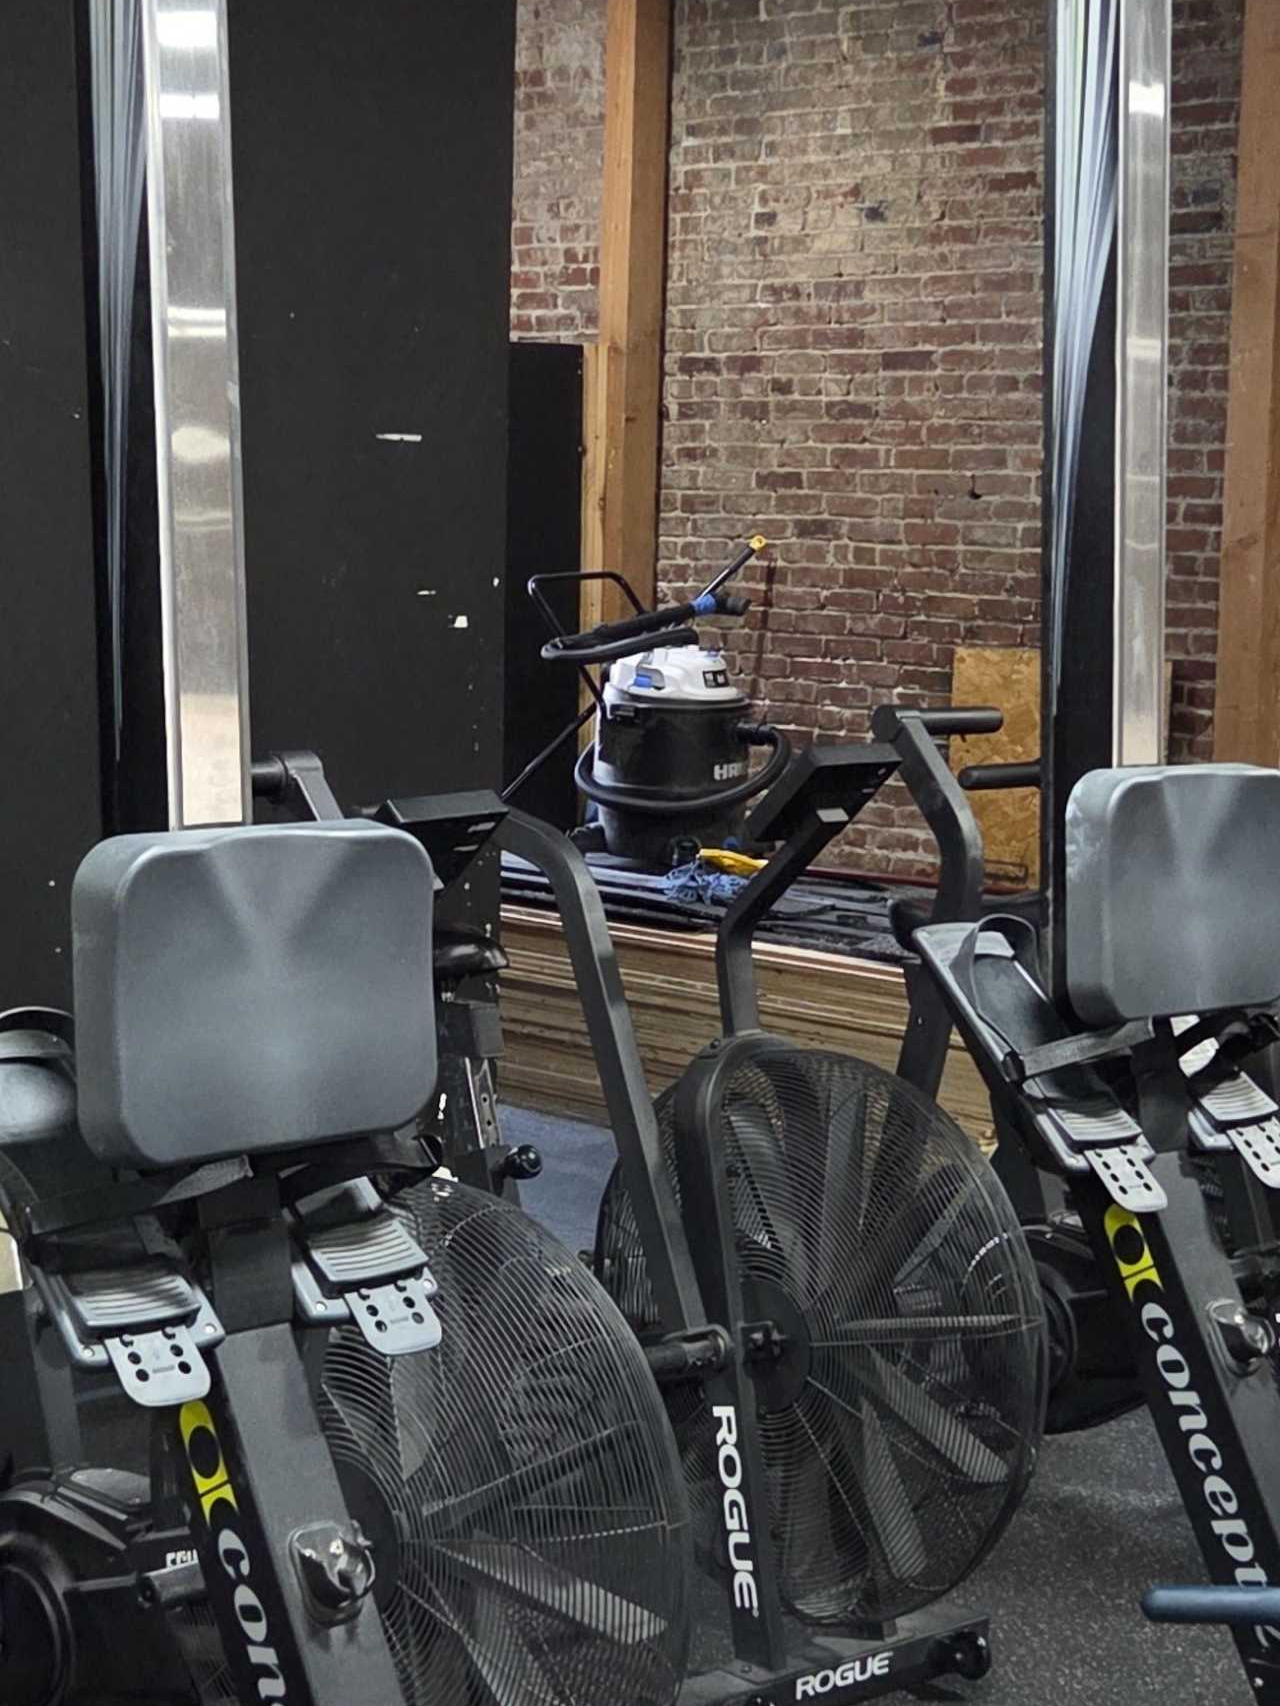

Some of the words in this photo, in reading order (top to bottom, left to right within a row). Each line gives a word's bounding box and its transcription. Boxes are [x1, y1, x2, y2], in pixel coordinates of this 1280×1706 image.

[711, 1404, 761, 1617] ROGUE
[1140, 1301, 1269, 1589] concept
[794, 1651, 894, 1702] ROGUE
